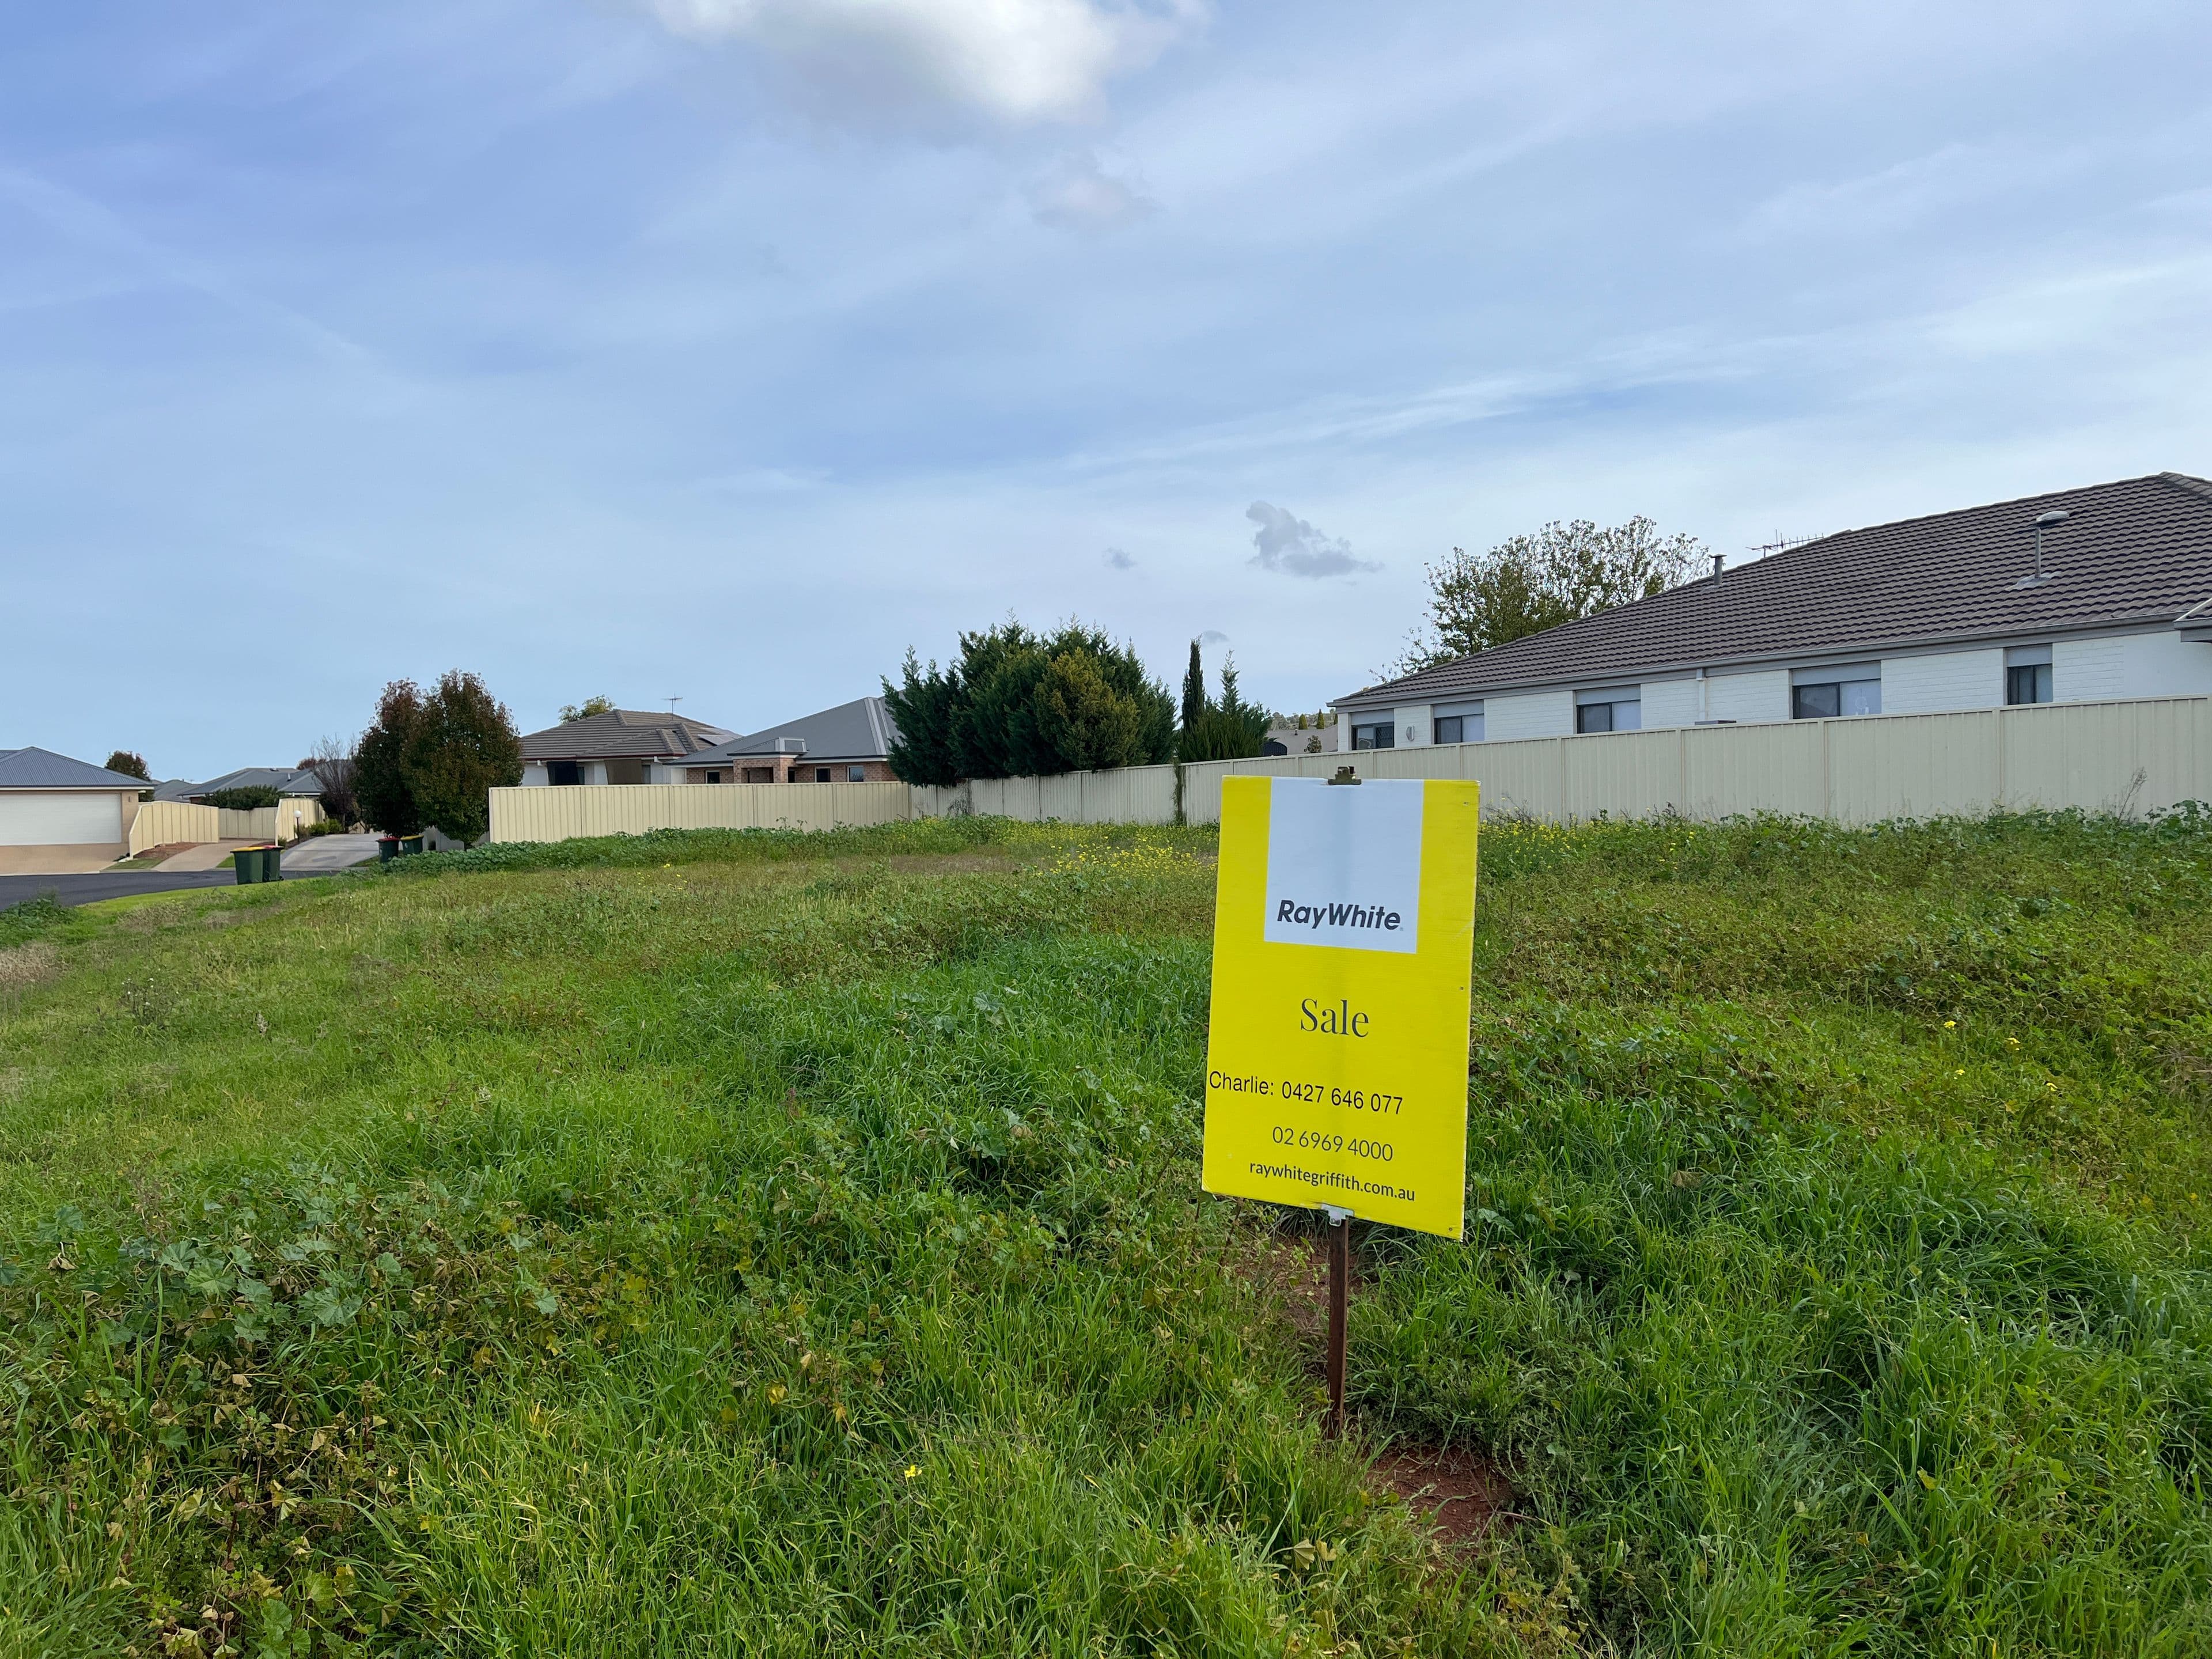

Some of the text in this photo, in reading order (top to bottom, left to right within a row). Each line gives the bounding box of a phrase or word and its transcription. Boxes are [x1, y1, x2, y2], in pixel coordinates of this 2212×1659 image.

[1300, 998, 1369, 1037] Sale
[1209, 1071, 1403, 1115] Charlie: 0427 646 077
[1272, 1126, 1393, 1161] 02 6969 4000
[1249, 1161, 1415, 1202] raywhitegriffith.com.au
